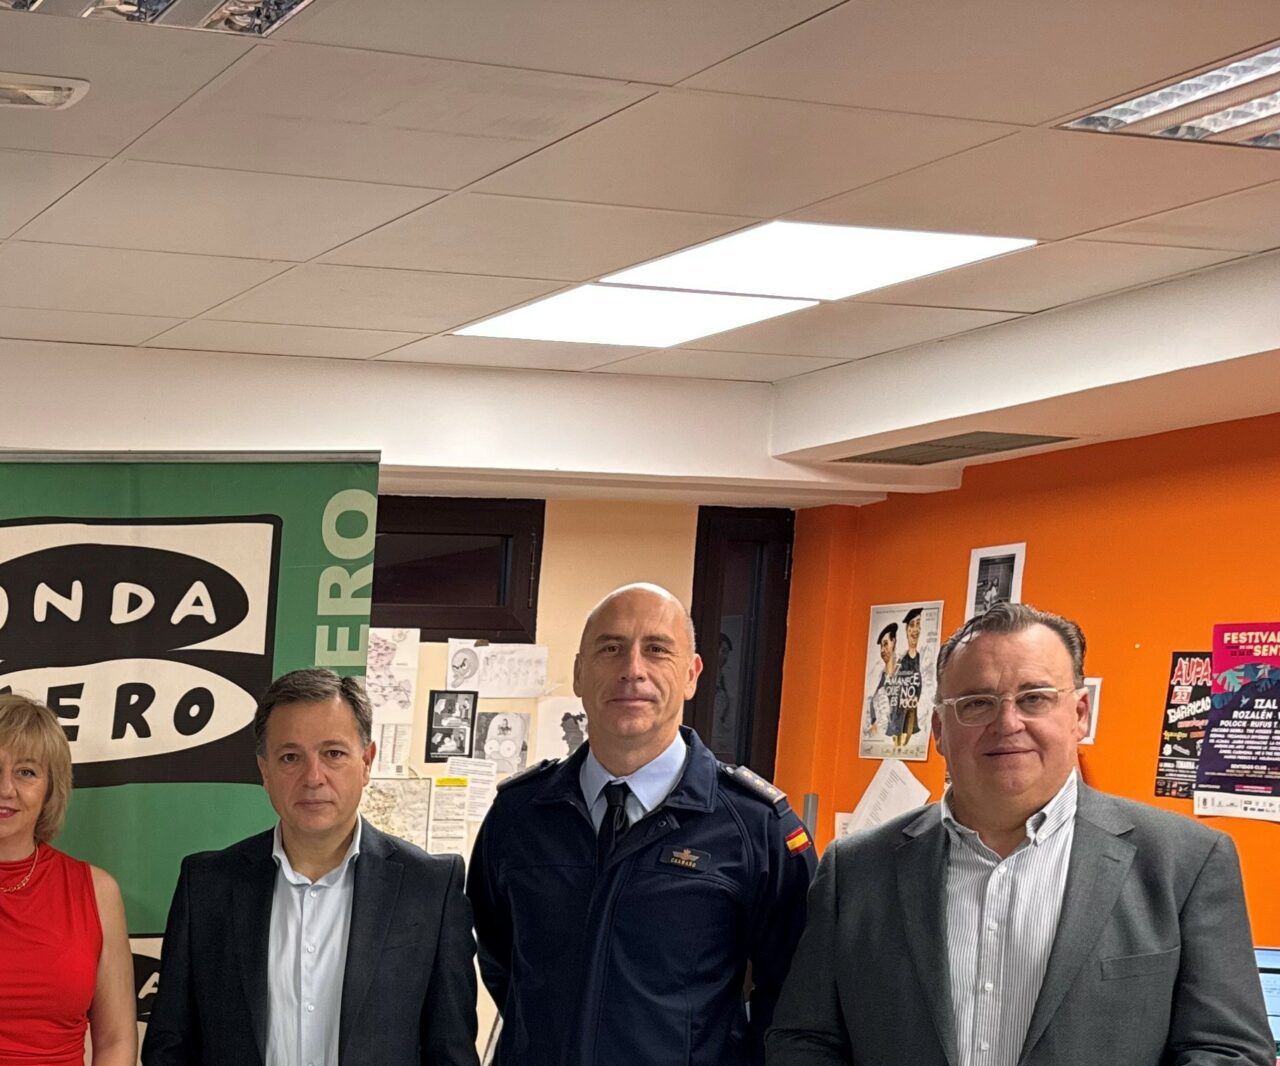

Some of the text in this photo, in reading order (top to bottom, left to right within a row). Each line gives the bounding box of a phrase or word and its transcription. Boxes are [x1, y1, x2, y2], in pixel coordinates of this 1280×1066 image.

[314, 488, 378, 680] ERO
[1253, 698, 1278, 710] IZAL
[1232, 709, 1273, 720] ROZALÉN
